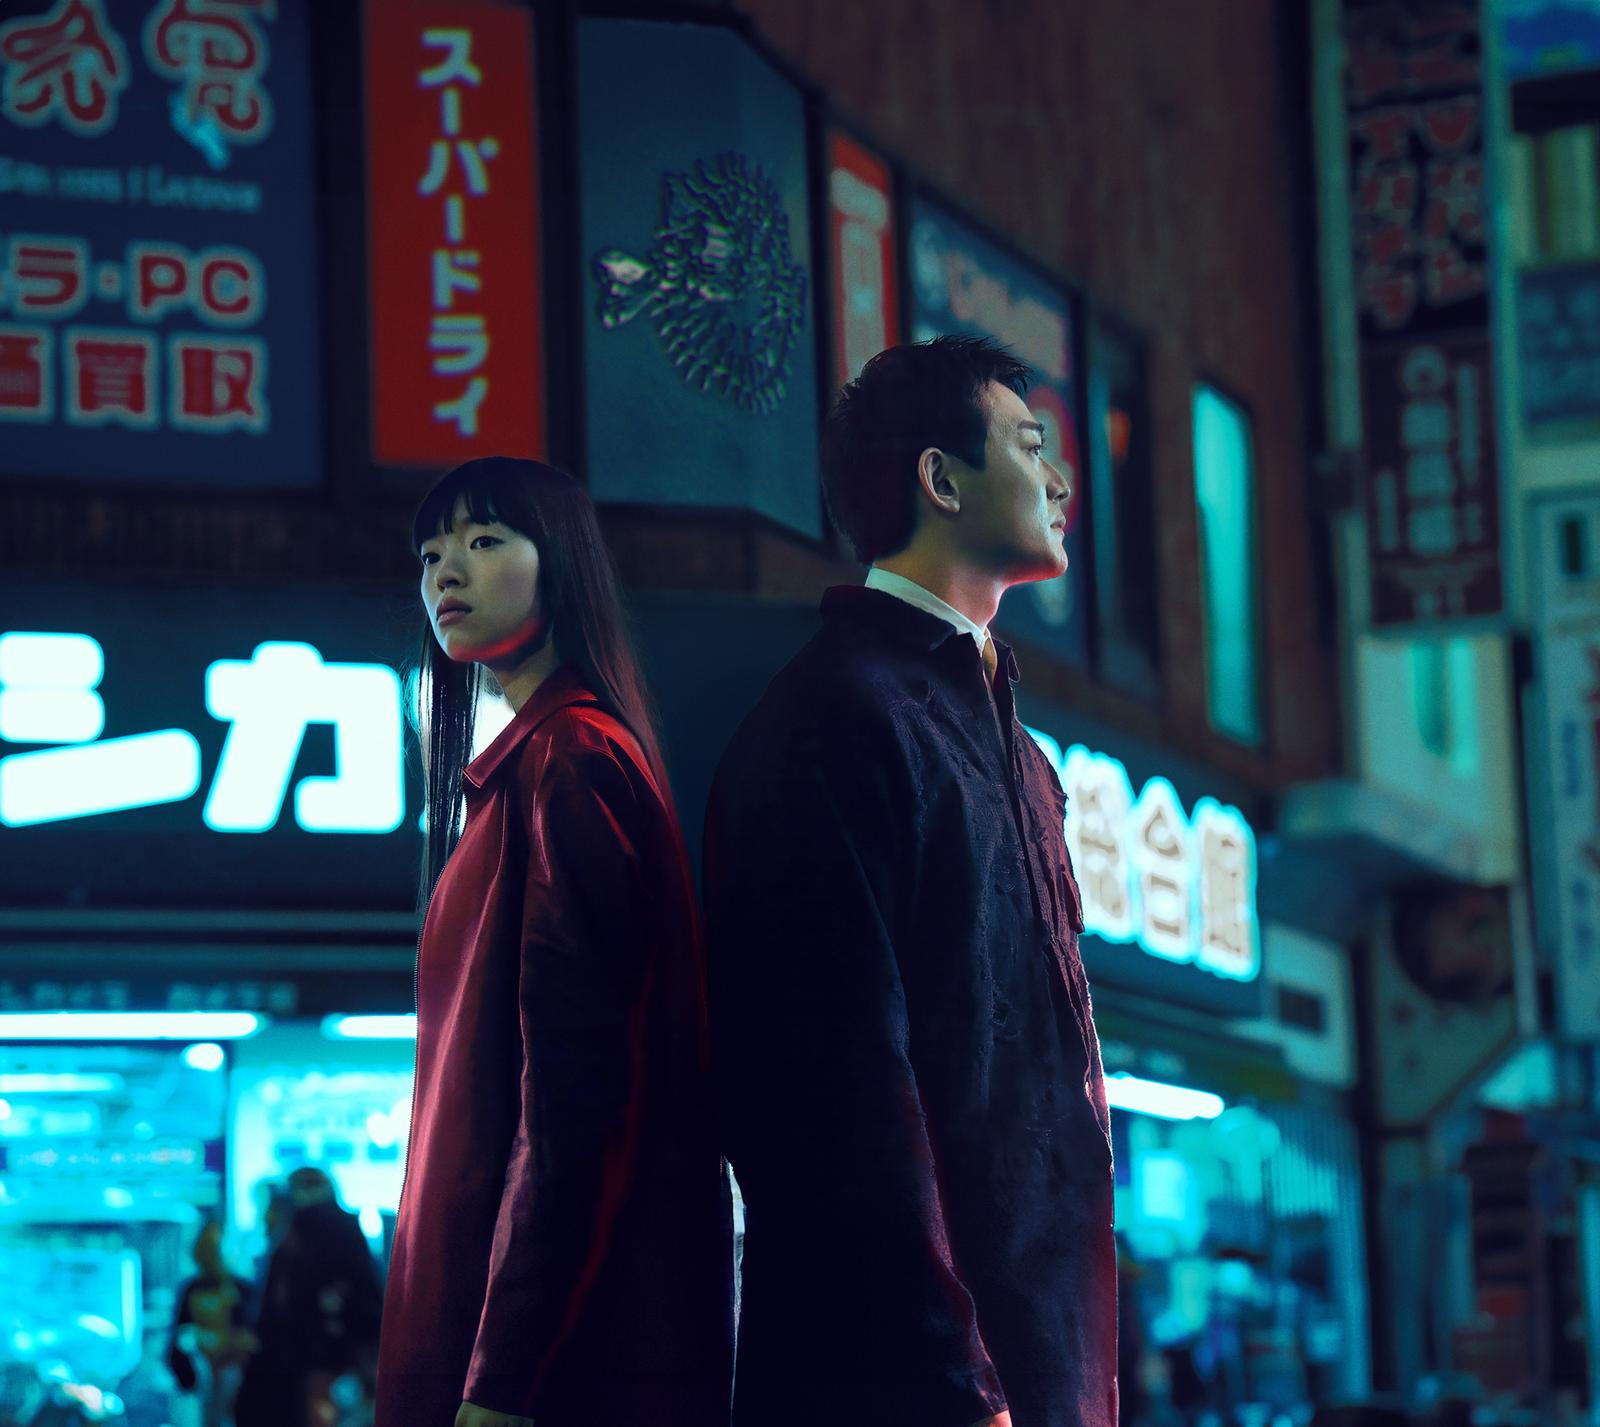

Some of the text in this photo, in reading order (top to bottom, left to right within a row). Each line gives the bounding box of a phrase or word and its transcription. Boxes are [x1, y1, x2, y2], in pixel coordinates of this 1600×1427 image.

[418, 27, 500, 438] スーパードライ
